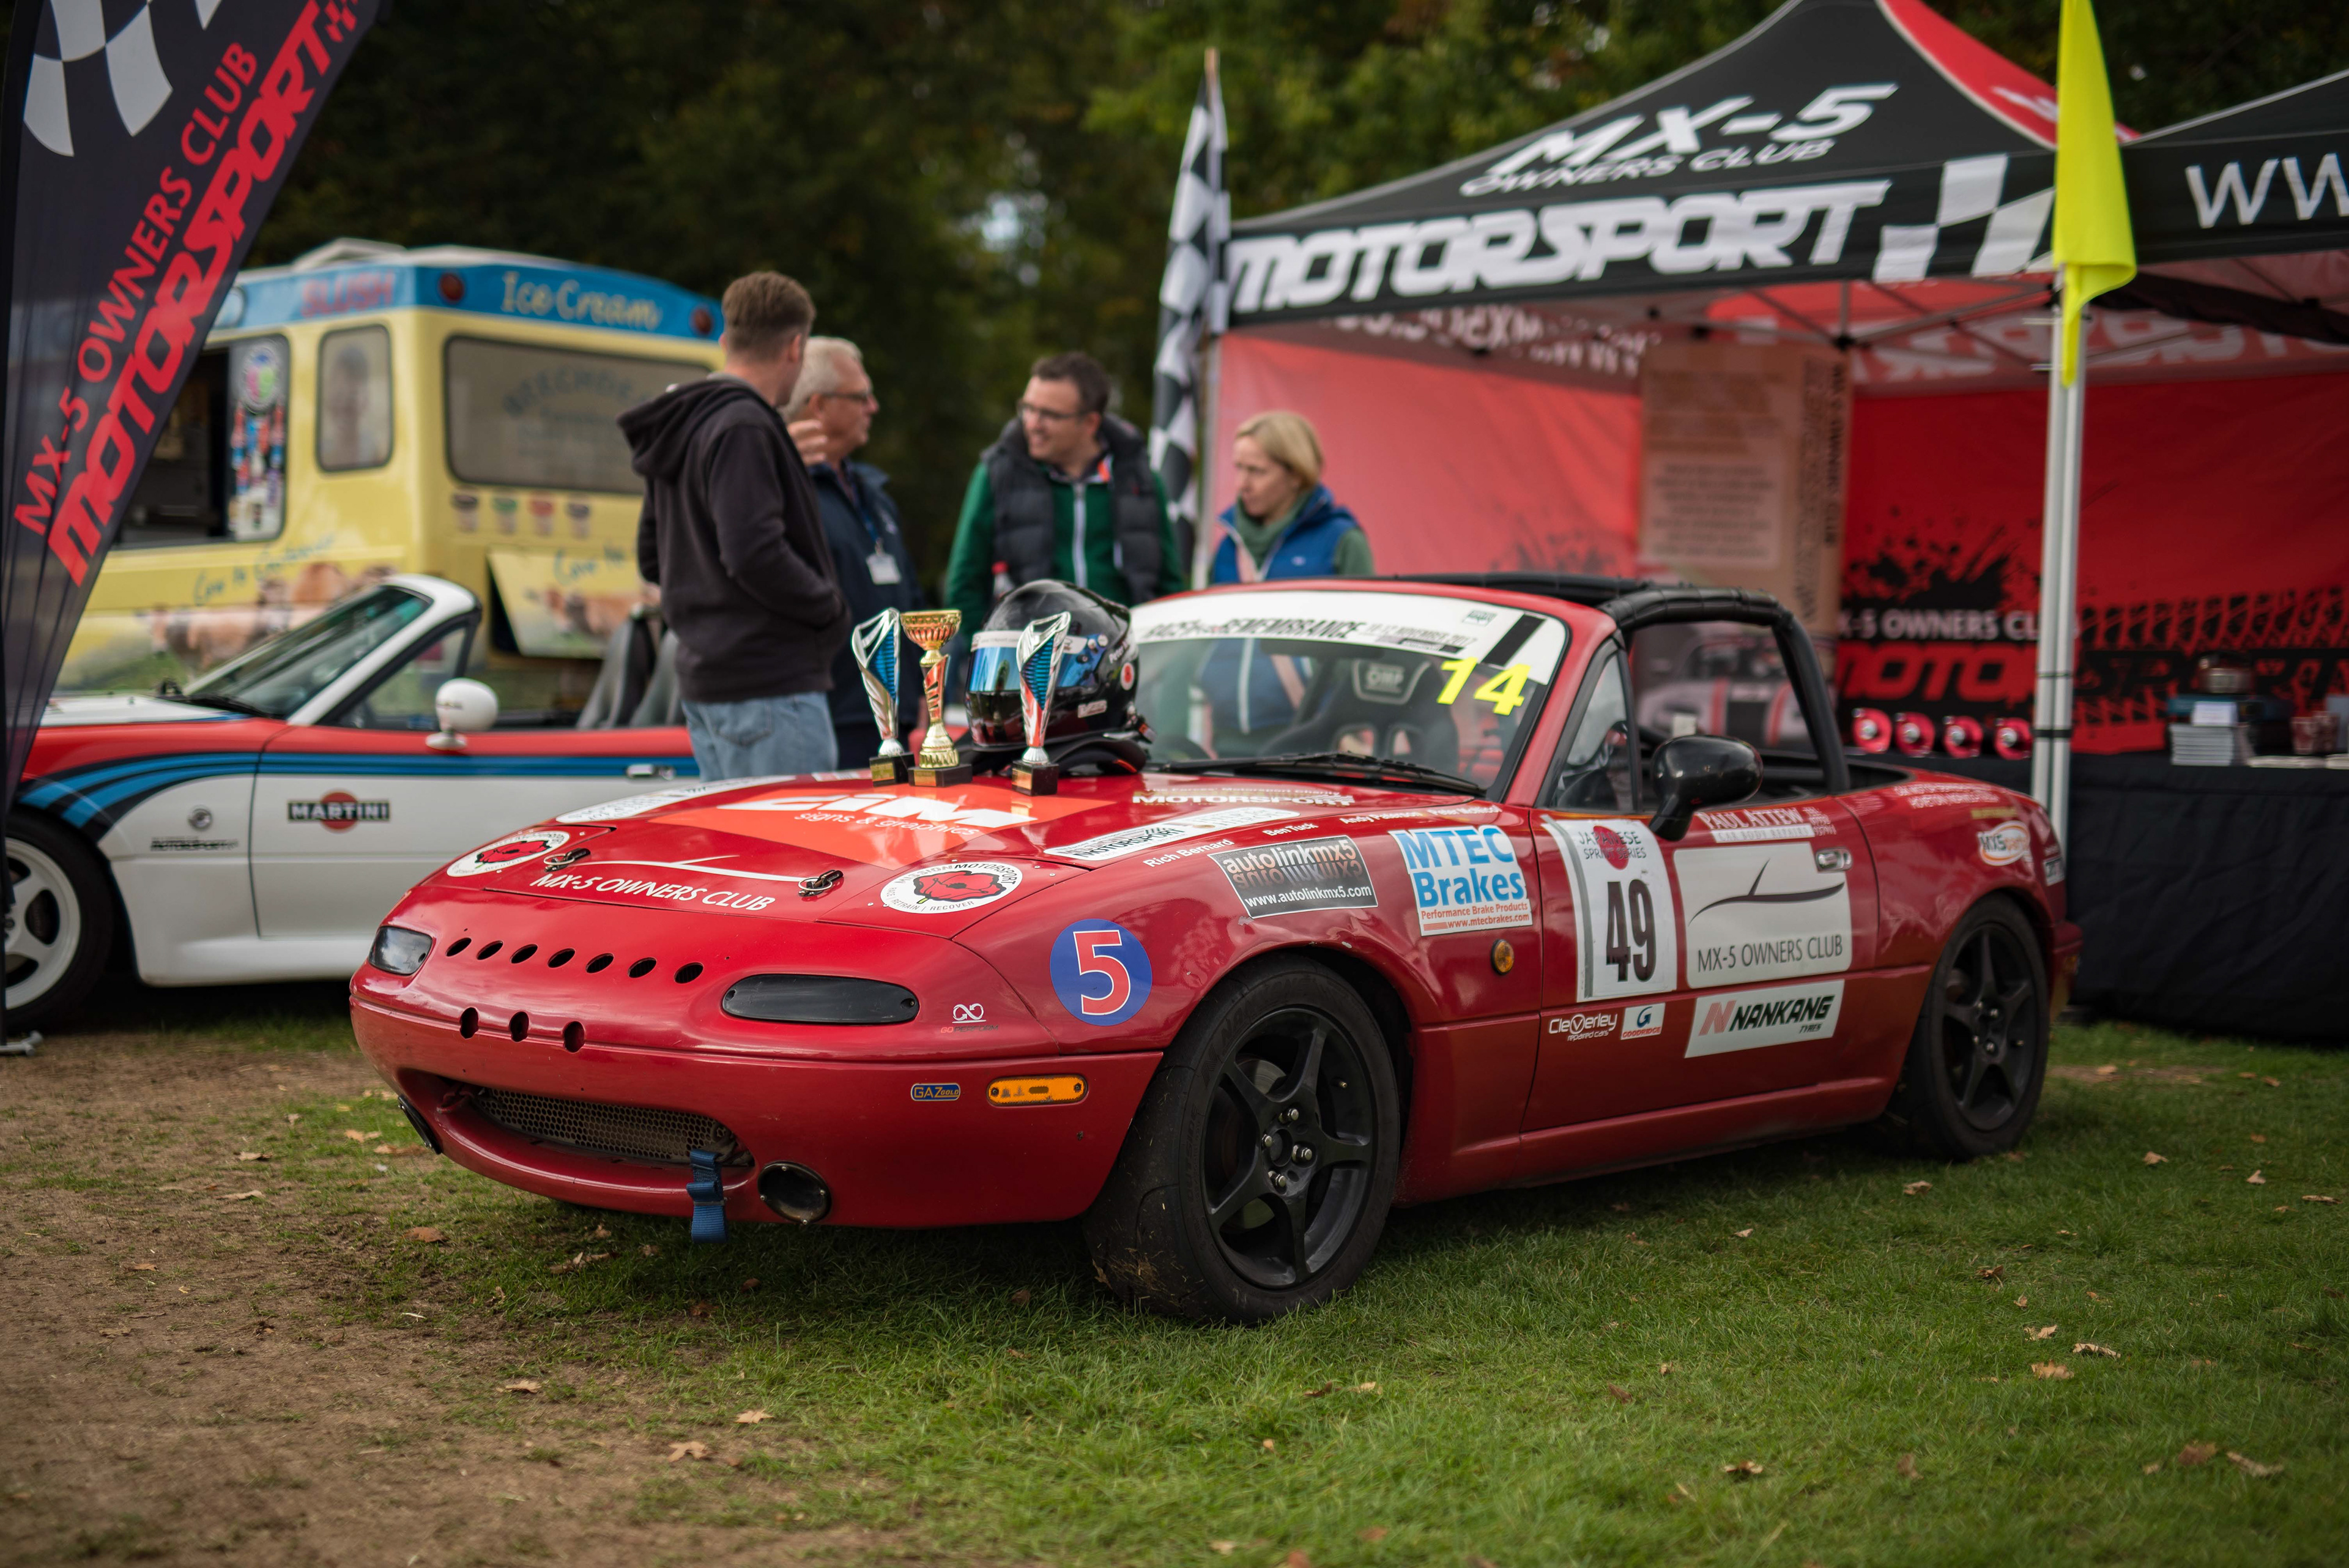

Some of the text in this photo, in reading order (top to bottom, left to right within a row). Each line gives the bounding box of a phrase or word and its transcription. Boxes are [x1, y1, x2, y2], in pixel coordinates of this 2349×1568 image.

[1483, 82, 1899, 174] MX-5
[1460, 139, 1835, 196] OWNERS CLUB
[1226, 180, 1892, 314] MOTORSPORT
[13, 42, 258, 535] MX-5 OWNERS CLUB
[47, 0, 334, 587] MOTORSPORT
[302, 270, 395, 321] SLUSH
[501, 270, 662, 331] Ice Cream
[1882, 609, 2001, 641] OWNERS
[1437, 657, 1531, 716] 14
[291, 803, 389, 820] MARTINI
[1132, 795, 1351, 806] MOTORSPORT
[794, 811, 855, 822] signs
[874, 819, 979, 835] graphics
[1262, 822, 1319, 836] Ben Tuck
[1339, 814, 1375, 825] Andy
[1694, 811, 1750, 830] PAUL
[1743, 807, 1804, 827] ATTEW
[1072, 828, 1186, 858] MOTORSPORT
[1394, 828, 1515, 869] MTEC
[1578, 831, 1642, 845] JAPANESE
[1143, 853, 1181, 868] Rich
[1176, 839, 1235, 857] Bernard
[1223, 839, 1356, 874] autolinkmx5
[1583, 847, 1647, 860] SPRINT SERIES
[894, 863, 1016, 885] MISSION MOTORSPORT
[1412, 868, 1524, 908] Brakes
[529, 873, 776, 911] MX-5 OWNERS CLUB
[891, 899, 976, 912] RETRAIN RECOVER
[1245, 885, 1373, 907] www.autolinkmx5.com
[1421, 902, 1528, 920] Performance Brake Products
[1447, 913, 1530, 929] www.mtecbrakes.com
[1606, 879, 1657, 983] 49
[1698, 934, 1843, 973] MX-5 OWNERS CLUB
[1073, 930, 1130, 1016] 5
[1728, 995, 1836, 1033] NANKANG
[1798, 1022, 1824, 1034] TYRES
[1567, 1030, 1609, 1042] repaired cars
[1622, 1026, 1661, 1038] GOODRIDGE
